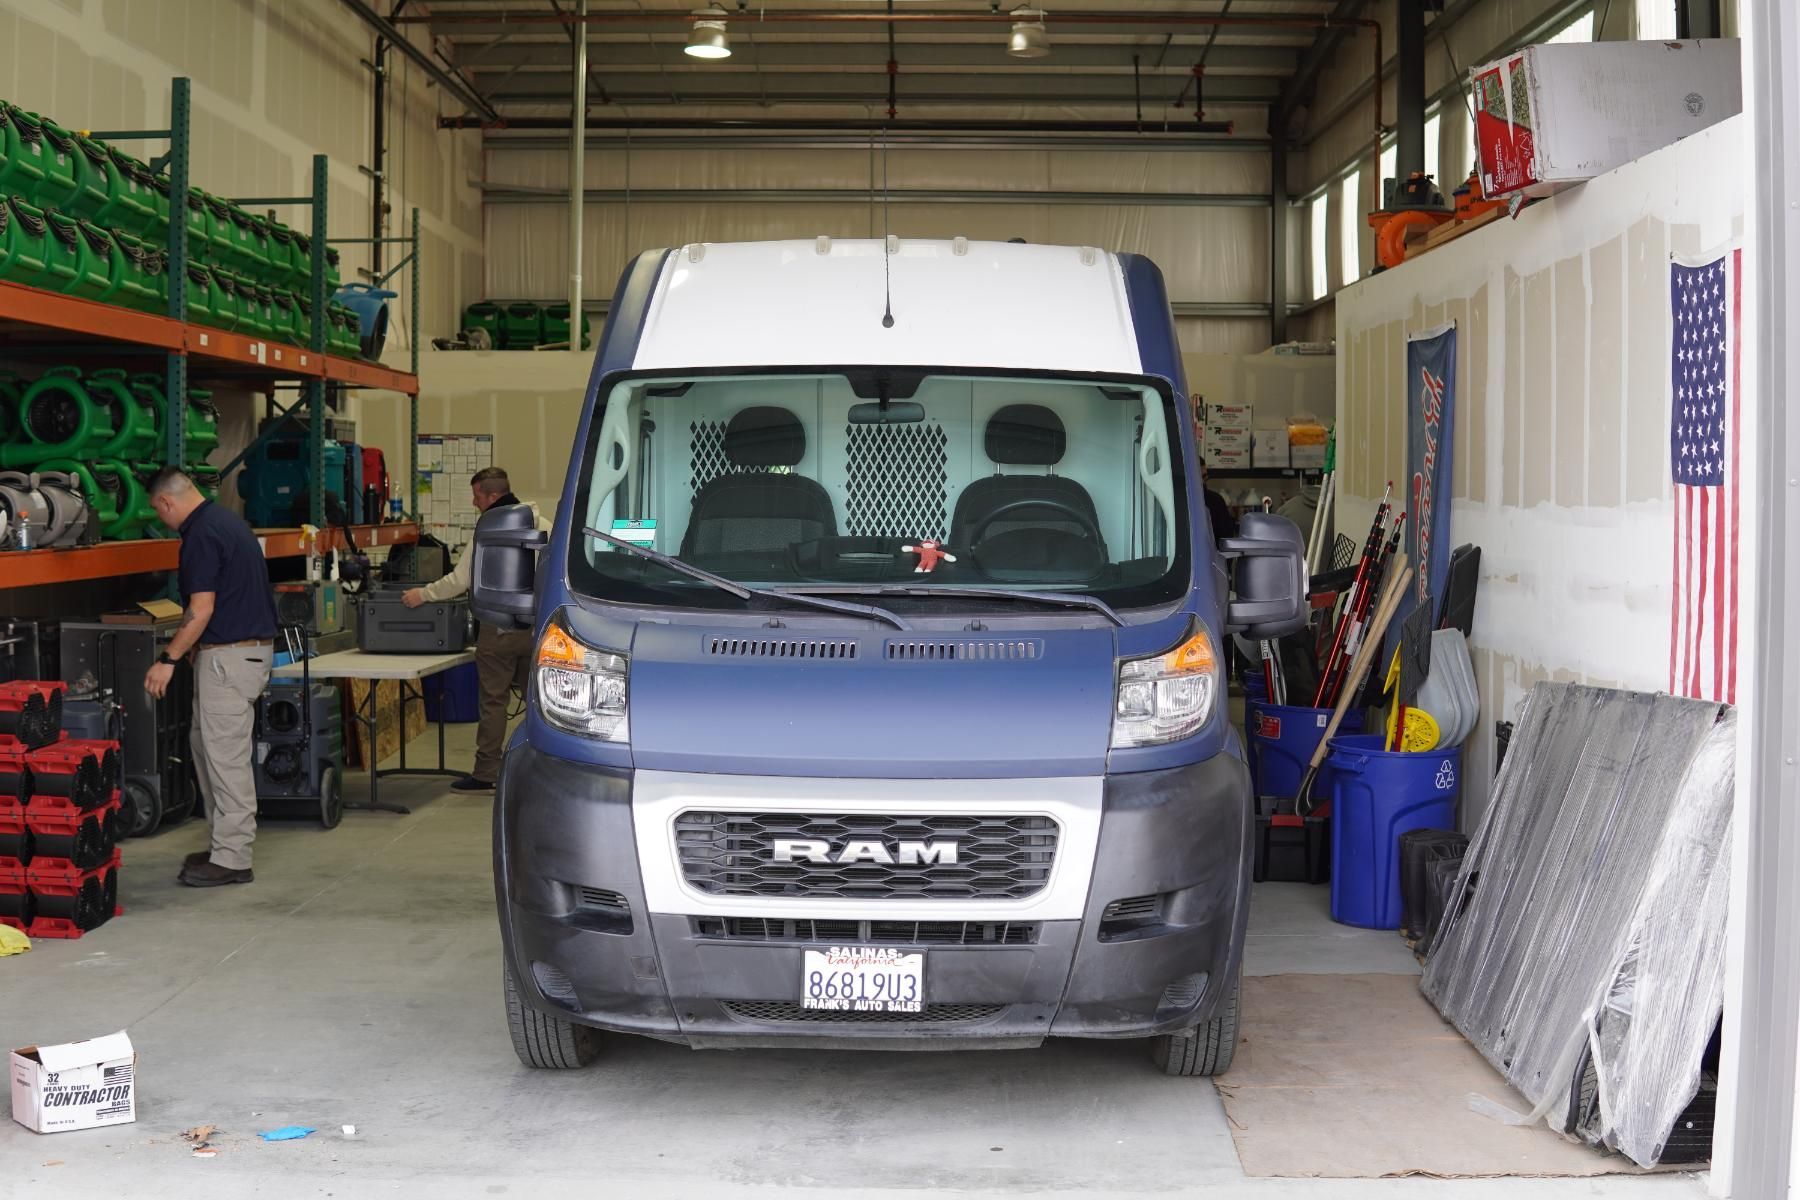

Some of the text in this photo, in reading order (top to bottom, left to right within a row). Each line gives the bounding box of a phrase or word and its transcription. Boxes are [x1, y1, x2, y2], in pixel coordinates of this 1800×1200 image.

[1419, 366, 1444, 605] Brave
[774, 840, 958, 864] RAM
[830, 946, 898, 959] SALINAS
[809, 971, 916, 1000] 86819U3
[804, 998, 921, 1012] FRANK'S AUTO SALES
[47, 1072, 60, 1083] 32
[44, 1085, 130, 1107] CONTRACTOR
